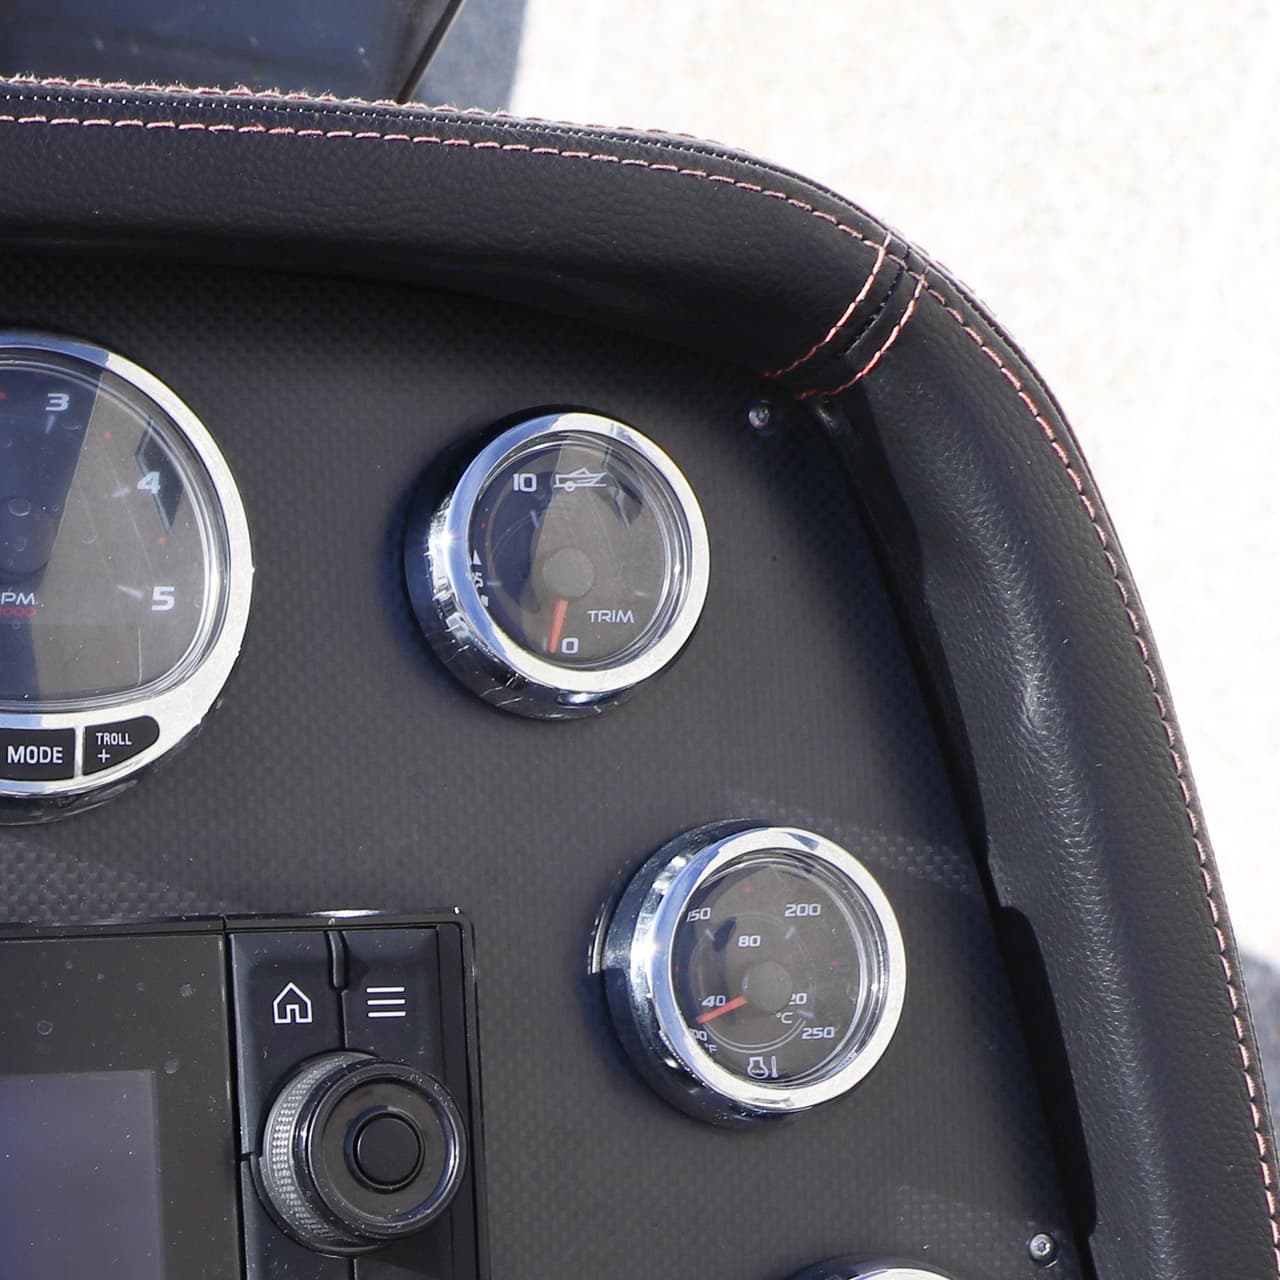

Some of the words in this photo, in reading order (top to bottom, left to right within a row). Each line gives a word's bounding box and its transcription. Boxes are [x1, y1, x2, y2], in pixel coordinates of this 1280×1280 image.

[45, 392, 69, 411] 3
[137, 471, 162, 494] 4
[513, 473, 537, 492] 10
[151, 586, 175, 612] 5
[587, 610, 634, 624] TRIM
[561, 638, 579, 654] 0
[95, 732, 133, 748] TROLL
[7, 746, 64, 766] MODE
[784, 903, 821, 917] 200
[738, 935, 761, 947] 80
[701, 995, 726, 1007] 40
[801, 1026, 835, 1040] 250
